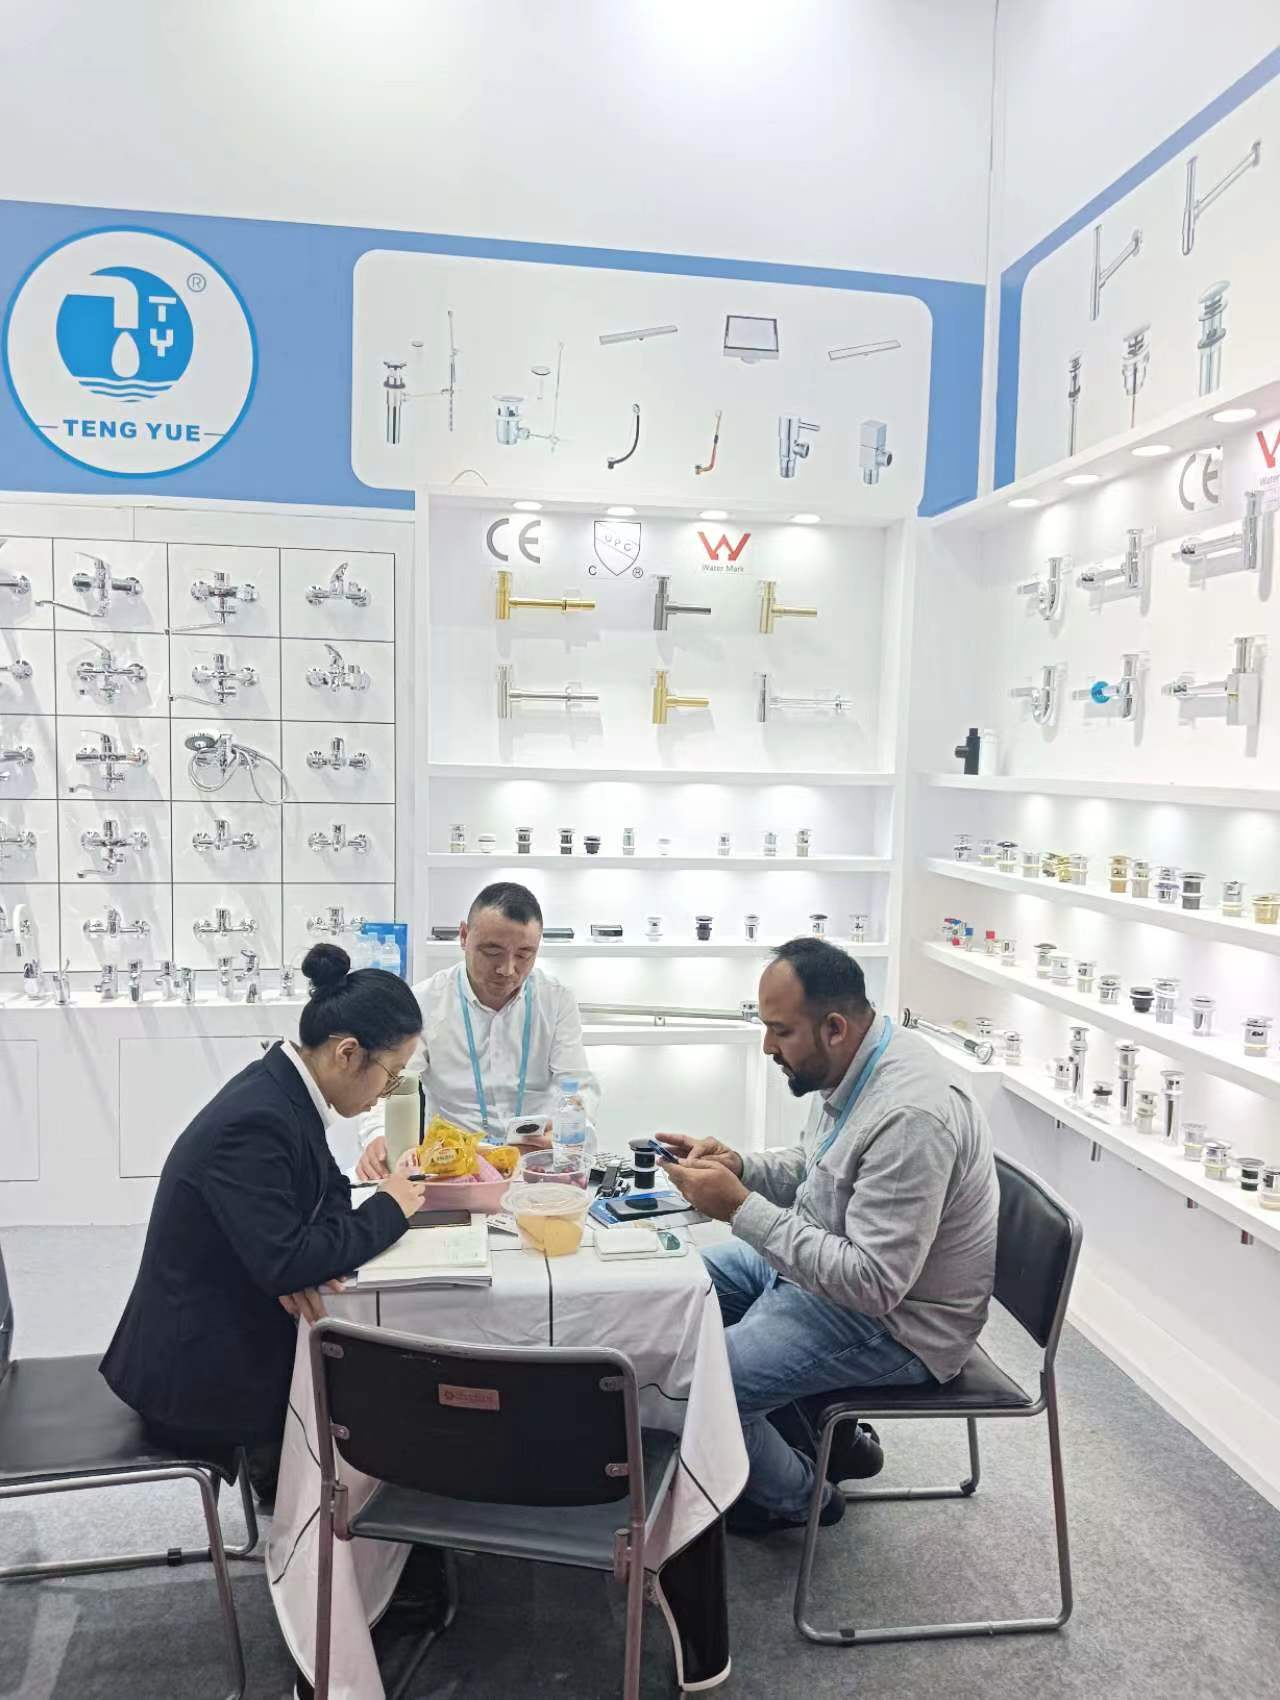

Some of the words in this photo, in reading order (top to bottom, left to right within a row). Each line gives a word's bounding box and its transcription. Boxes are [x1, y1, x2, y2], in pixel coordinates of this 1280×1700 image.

[63, 419, 137, 439] TENG
[145, 422, 200, 442] YUE
[1179, 453, 1219, 511] CE
[486, 518, 541, 564] CE
[604, 535, 632, 552] UPC
[588, 565, 598, 576] C
[702, 564, 724, 573] Water
[726, 565, 744, 574] Mark
